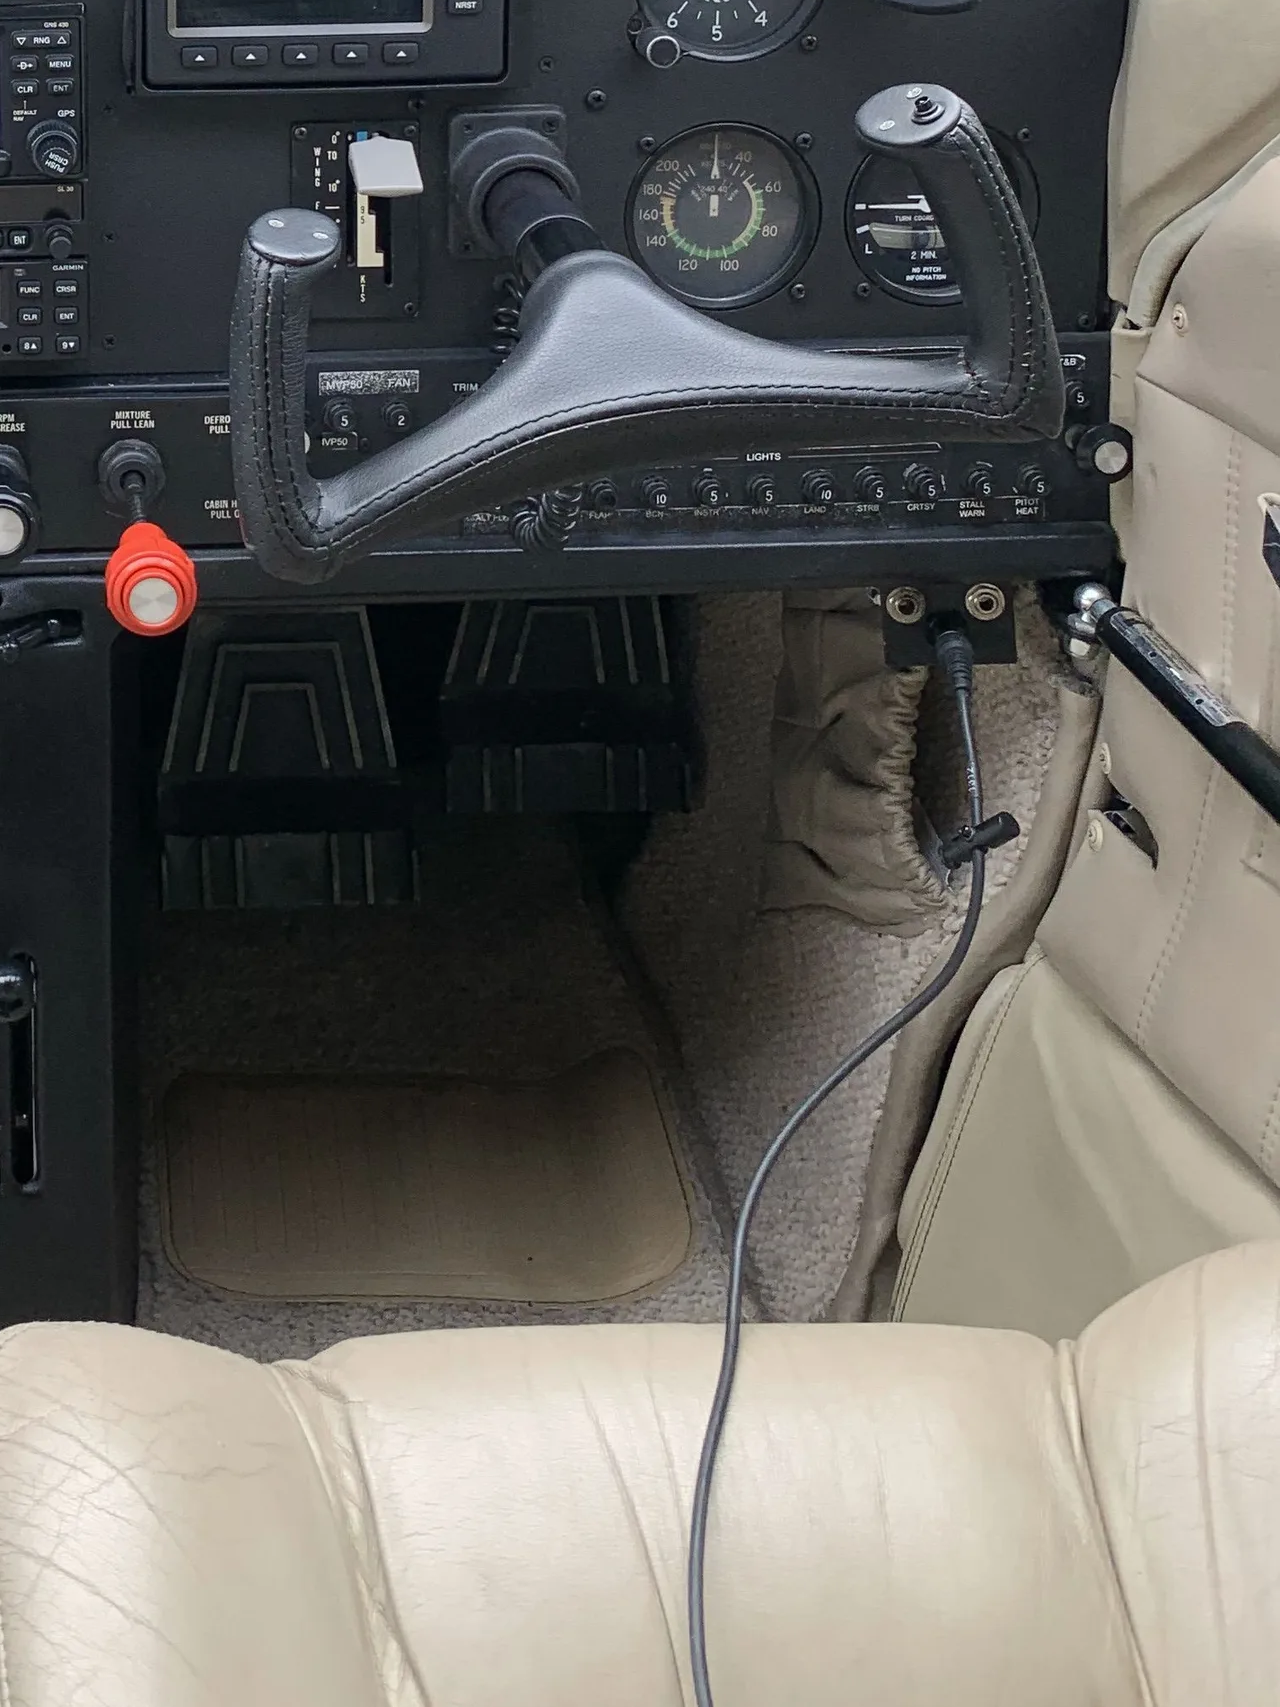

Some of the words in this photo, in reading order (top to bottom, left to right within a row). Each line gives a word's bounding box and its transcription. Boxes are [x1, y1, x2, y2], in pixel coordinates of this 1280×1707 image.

[736, 152, 751, 162] 40
[656, 161, 679, 172] 200
[643, 184, 662, 195] 180
[765, 182, 781, 192] 60
[639, 209, 658, 220] 160
[761, 226, 777, 236] 80
[646, 236, 666, 246] 140
[678, 260, 697, 271] 120
[720, 260, 739, 271] 100
[453, 383, 479, 392] TRIM
[115, 411, 150, 420] MIXTURE
[111, 420, 130, 429] PULL
[133, 420, 155, 429] LEAN
[747, 453, 781, 462] LIGHTS
[204, 501, 228, 510] CABIN
[960, 501, 985, 509] STALL
[1015, 498, 1039, 506] PITOT
[804, 506, 826, 514] LAND
[856, 504, 879, 512] STRB
[907, 503, 934, 511] CRTSY
[1016, 507, 1038, 515] HEAT
[211, 509, 231, 519] PULL
[694, 508, 719, 516] INSTR
[960, 509, 985, 517] WARN
